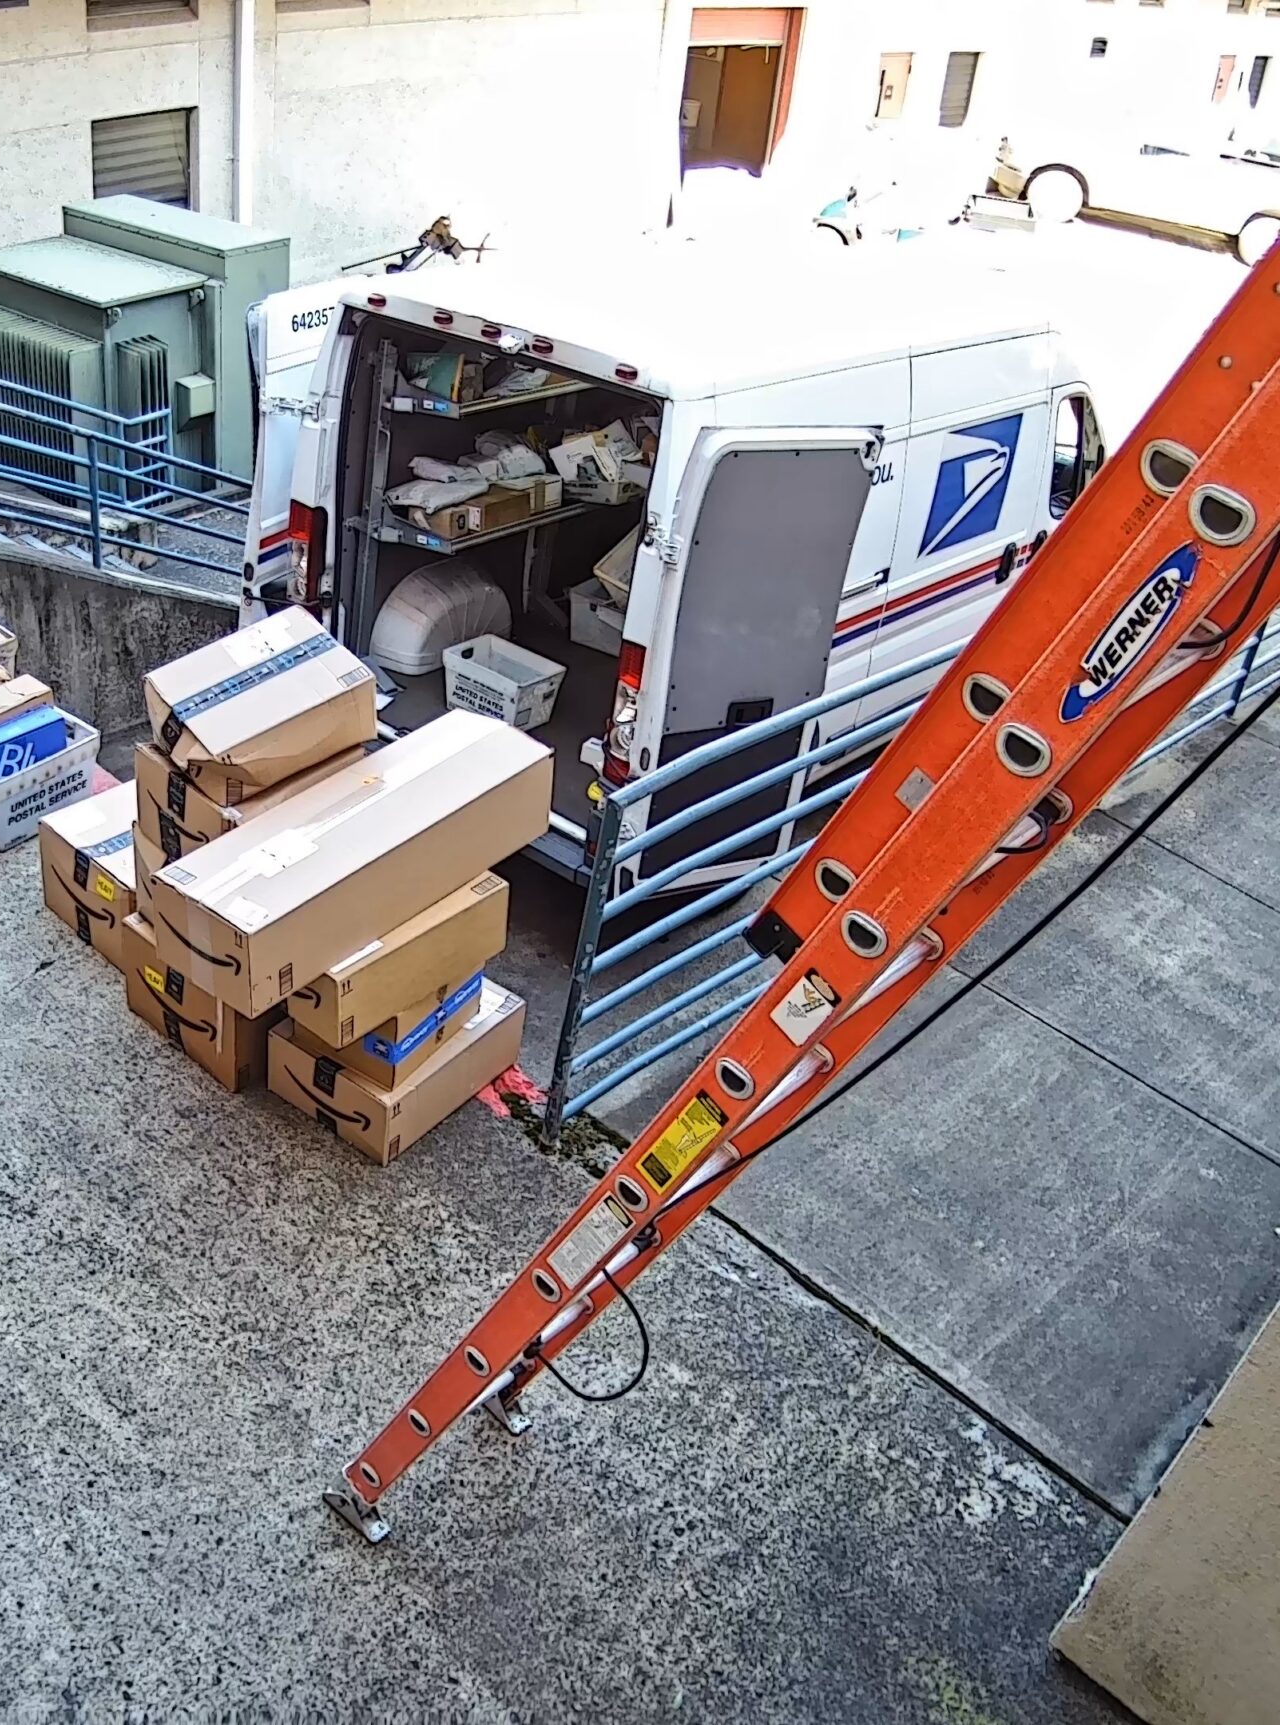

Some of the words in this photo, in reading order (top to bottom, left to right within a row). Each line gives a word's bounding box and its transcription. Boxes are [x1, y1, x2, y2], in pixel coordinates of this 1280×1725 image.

[1089, 576, 1174, 687] WERNER
[452, 691, 476, 707] POSTAL
[478, 704, 504, 720] SERVICE
[455, 684, 478, 700] UNITED
[480, 695, 504, 711] STATES
[7, 802, 47, 826] POSTAL
[48, 779, 88, 807] SERVICE
[10, 789, 45, 813] UNITED
[48, 770, 84, 795] STATES
